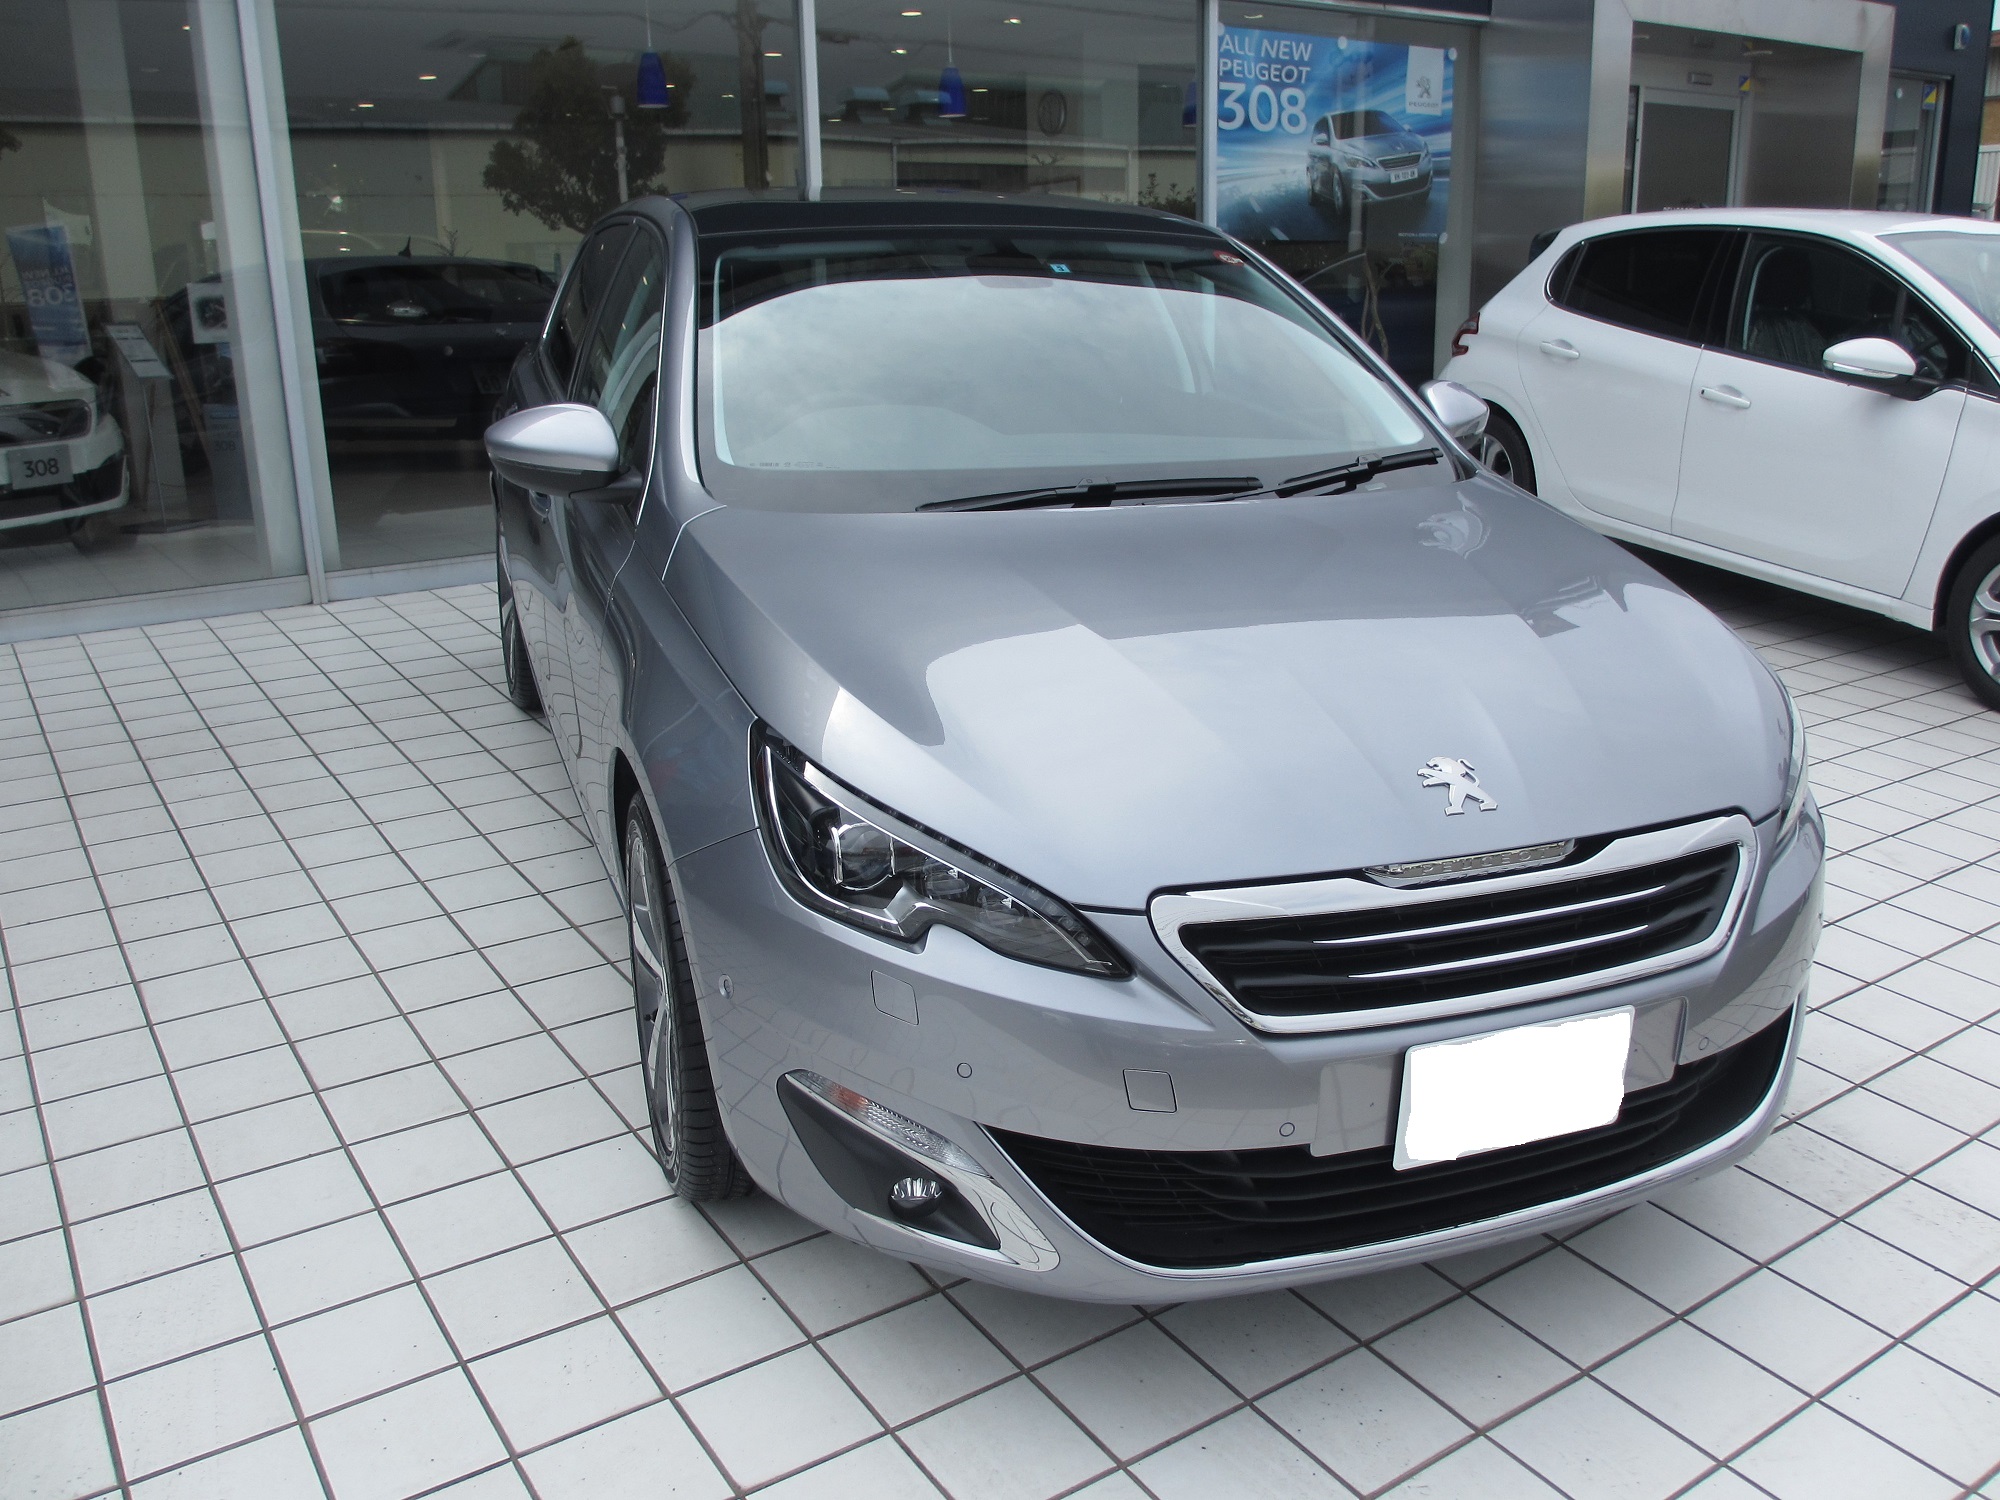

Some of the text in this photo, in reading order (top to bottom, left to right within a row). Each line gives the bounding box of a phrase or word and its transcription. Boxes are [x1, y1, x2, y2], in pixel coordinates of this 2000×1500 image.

[1220, 34, 1313, 62] ALL NEW
[1219, 58, 1311, 84] PEUGEOT
[1218, 82, 1307, 134] 308
[23, 457, 60, 479] 308
[1422, 848, 1549, 875] PEUGEOT
